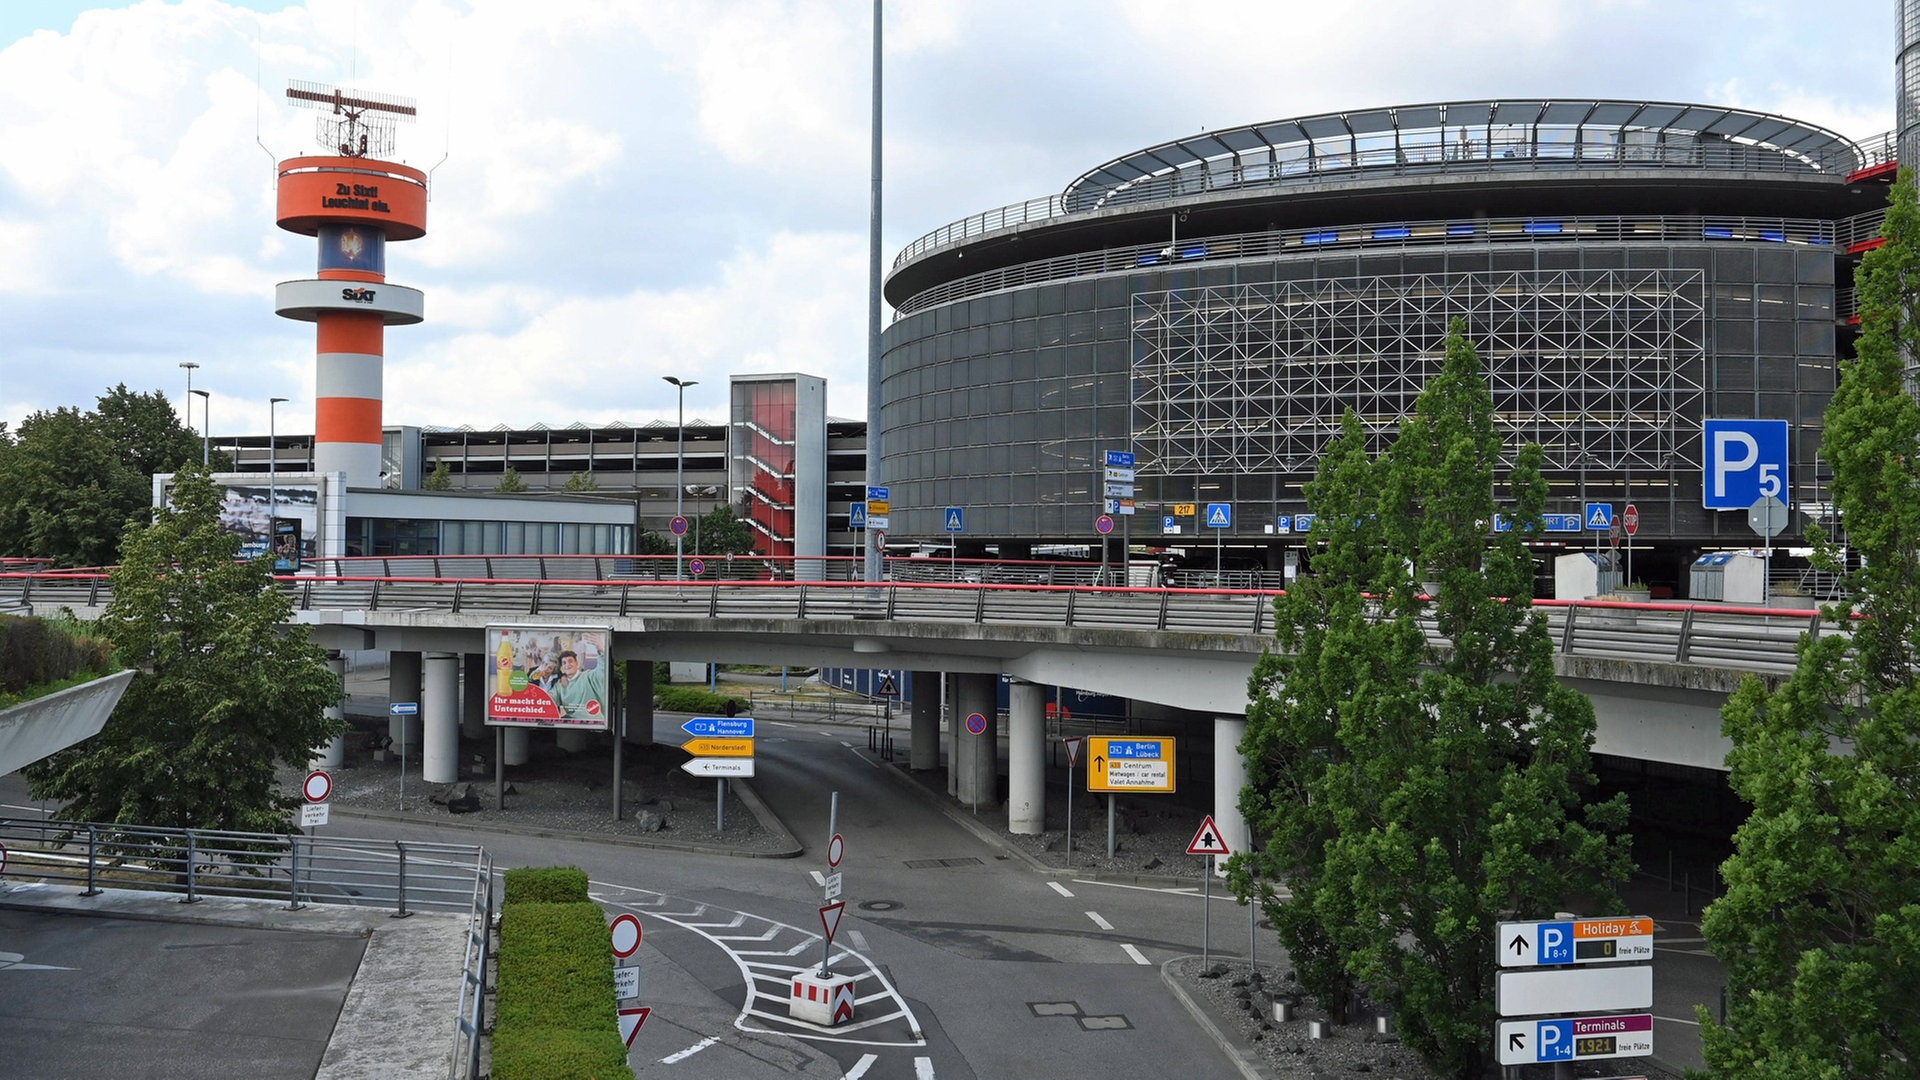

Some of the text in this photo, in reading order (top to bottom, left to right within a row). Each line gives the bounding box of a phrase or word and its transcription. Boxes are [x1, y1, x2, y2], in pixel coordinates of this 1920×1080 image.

[336, 183, 350, 195] Zu
[1178, 505, 1190, 514] 217
[1625, 514, 1638, 526] STOP
[510, 698, 534, 706] macht
[1583, 923, 1625, 936] Holiday
[1603, 941, 1612, 955] 0
[1633, 945, 1650, 953] Plätze
[1575, 1022, 1626, 1032] Terminals
[1579, 1038, 1611, 1053] 1921
